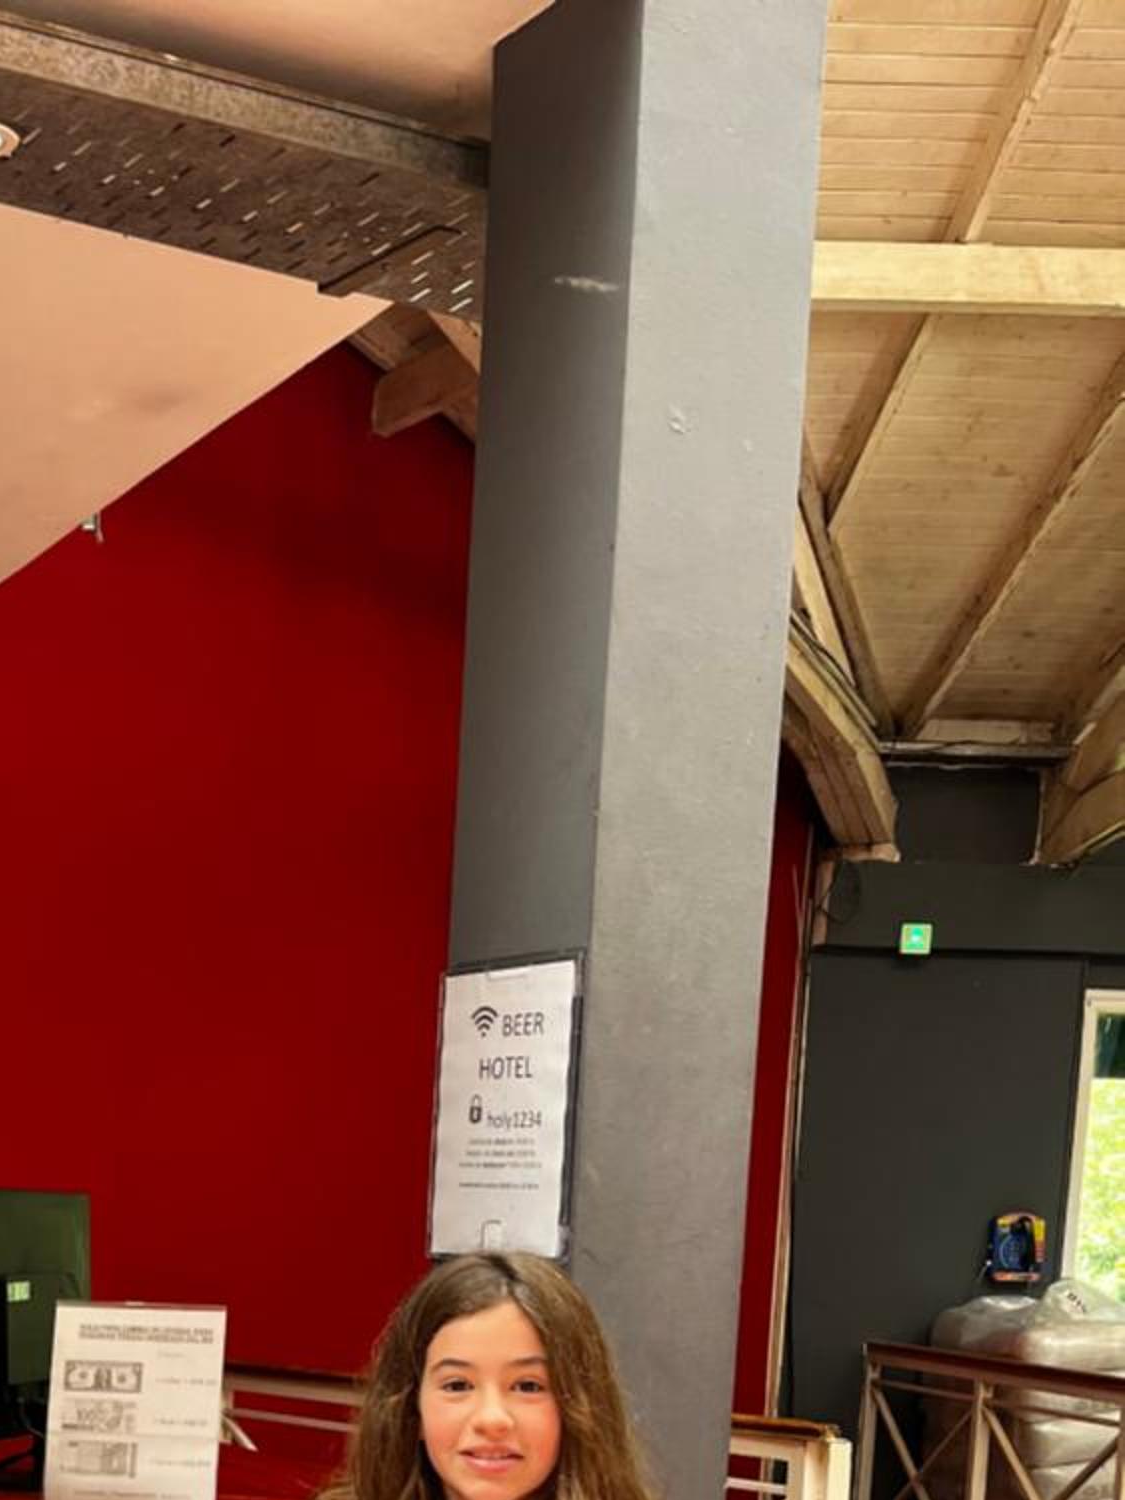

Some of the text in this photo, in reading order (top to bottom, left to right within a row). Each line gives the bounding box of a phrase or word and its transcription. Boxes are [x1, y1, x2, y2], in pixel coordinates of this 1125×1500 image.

[501, 1011, 545, 1037] BEER
[478, 1055, 534, 1080] HOTEL
[486, 1109, 543, 1131] holy1234
